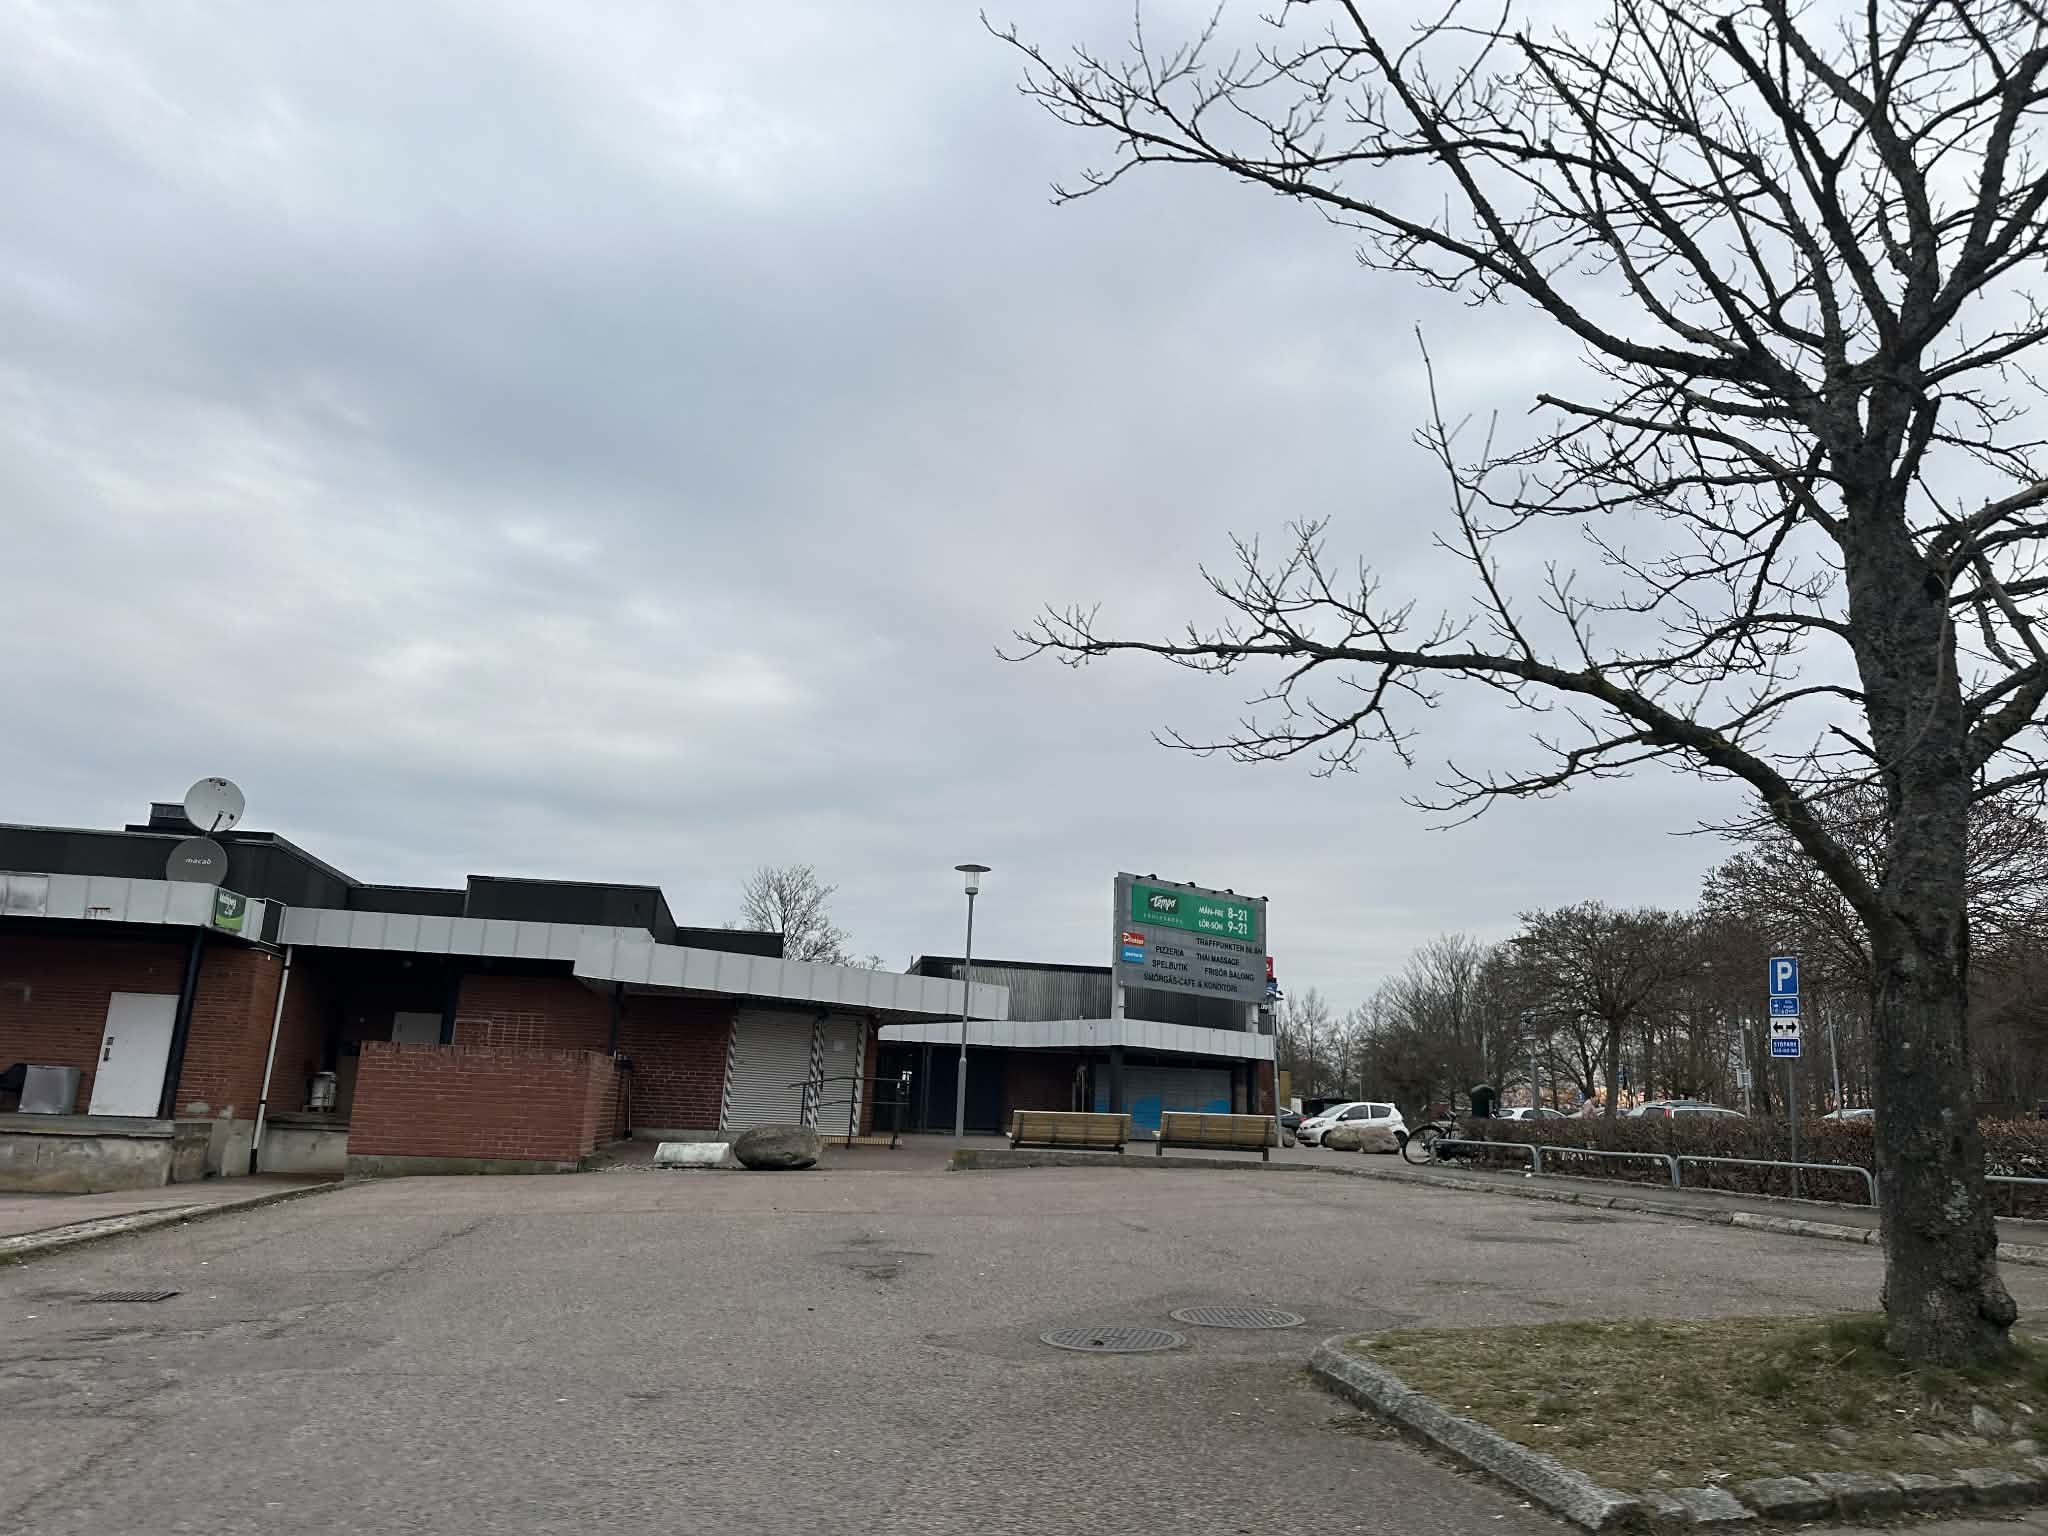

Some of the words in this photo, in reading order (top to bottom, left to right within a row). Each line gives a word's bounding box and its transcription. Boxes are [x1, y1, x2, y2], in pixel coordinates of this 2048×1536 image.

[1227, 907, 1248, 921] 8-21
[1227, 921, 1248, 935] 9-21
[1155, 945, 1185, 957] PIZZERIA
[1151, 959, 1188, 971] SPELBUTIK
[1196, 952, 1210, 961] THAI
[1211, 955, 1240, 966] MASSAGE
[1204, 967, 1228, 977] FRISÖR
[1776, 961, 1793, 992] P
